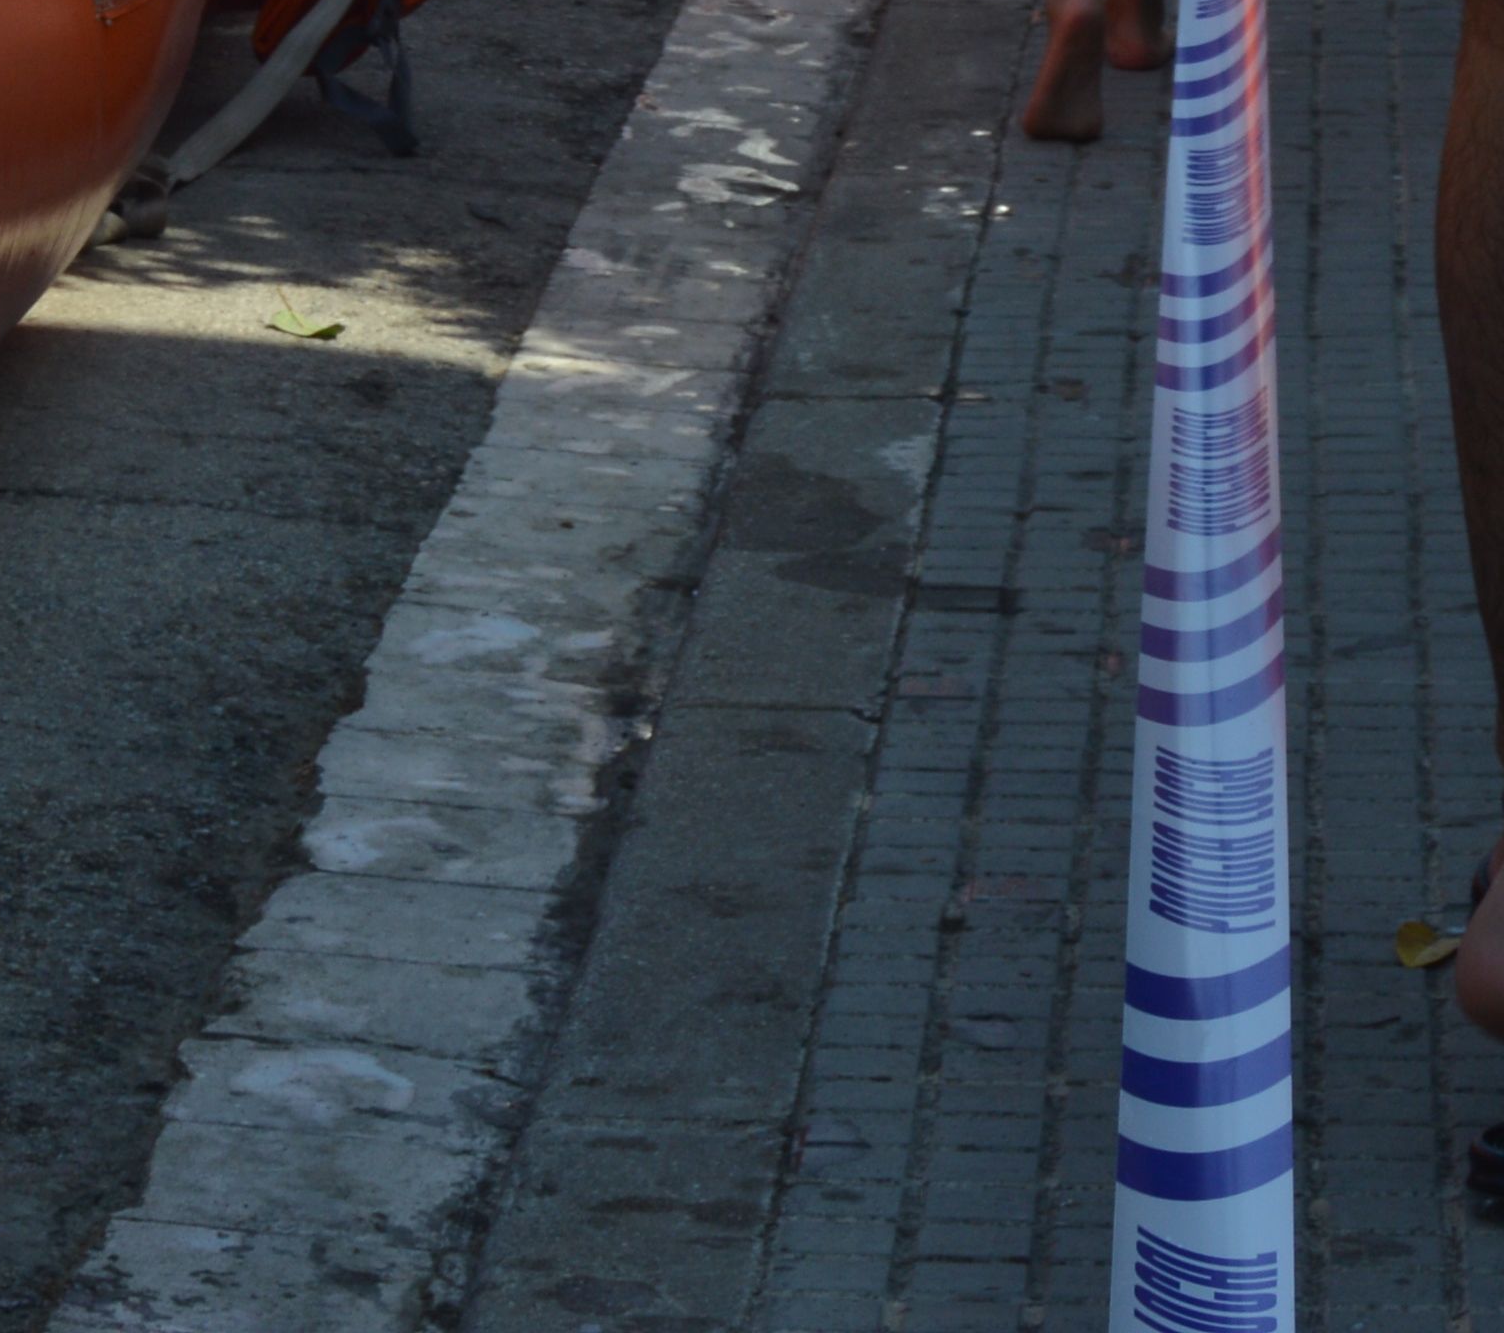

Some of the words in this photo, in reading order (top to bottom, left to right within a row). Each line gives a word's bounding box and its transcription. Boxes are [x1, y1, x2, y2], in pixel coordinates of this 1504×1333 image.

[1170, 386, 1268, 461] LOCAL
[1167, 444, 1272, 537] POLICIA
[1153, 745, 1274, 826] LOCAL
[1149, 821, 1276, 935] POLICIA
